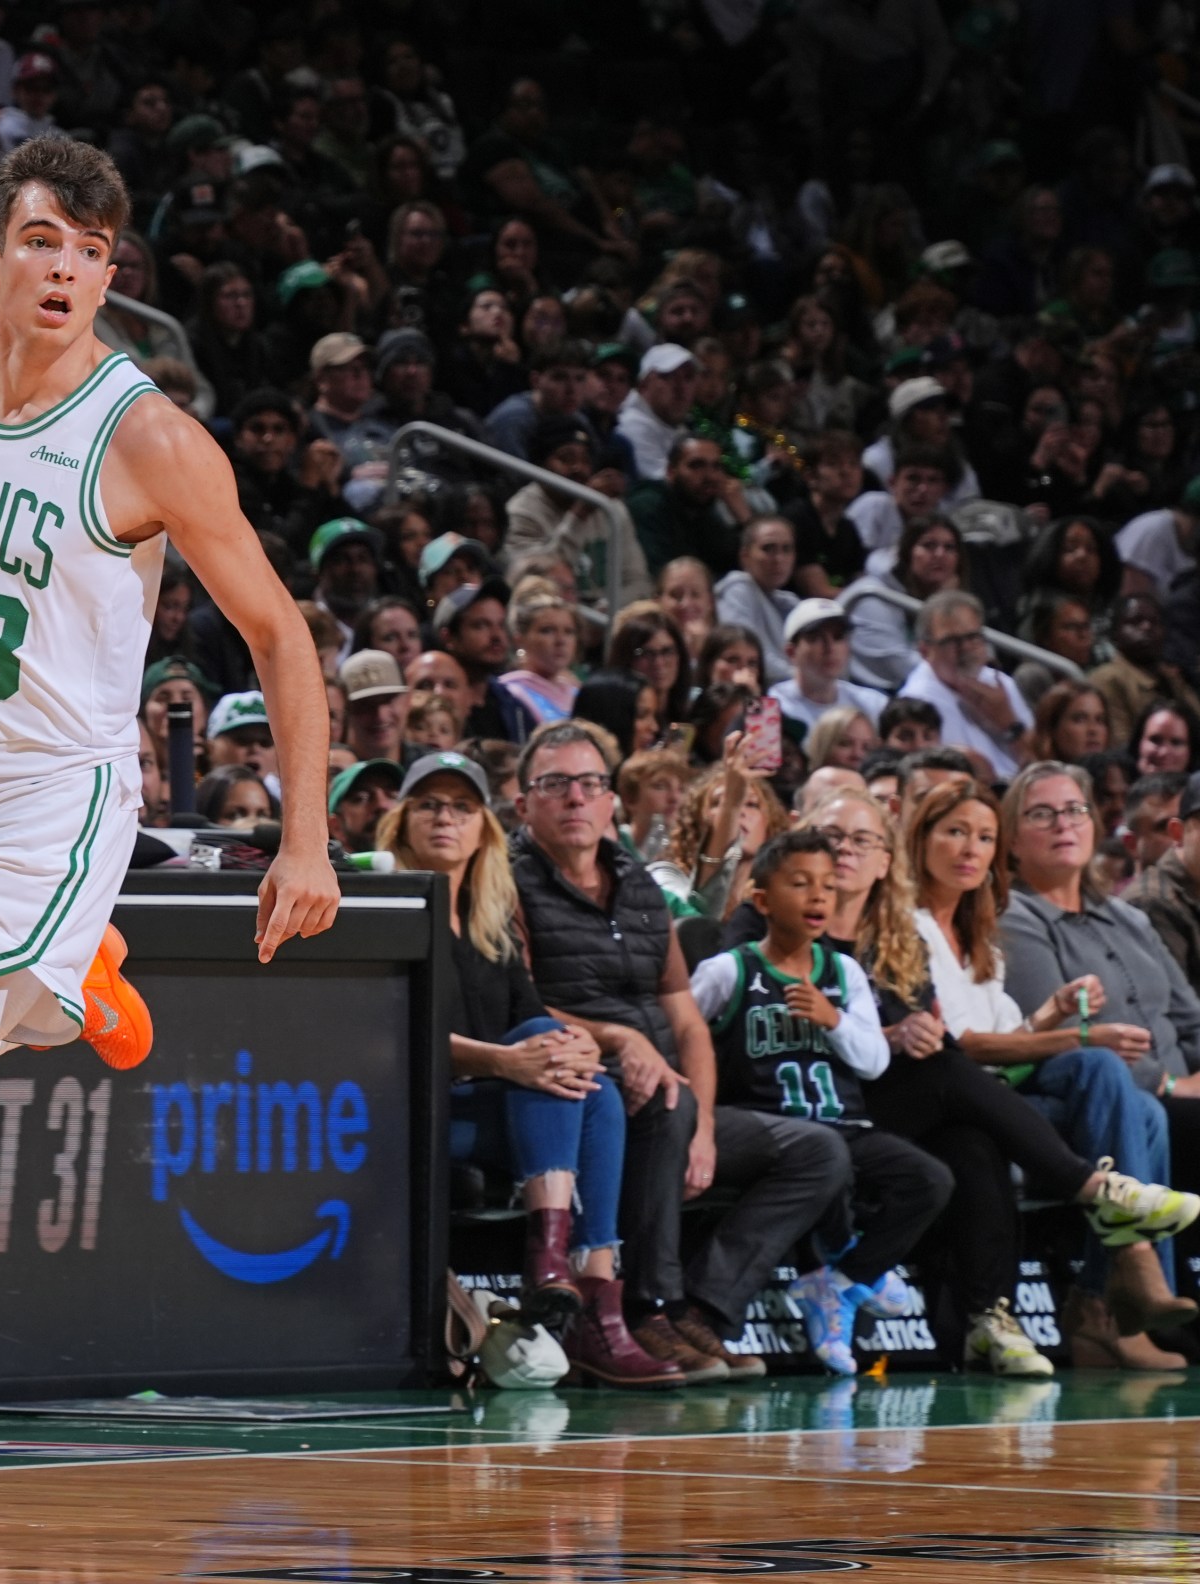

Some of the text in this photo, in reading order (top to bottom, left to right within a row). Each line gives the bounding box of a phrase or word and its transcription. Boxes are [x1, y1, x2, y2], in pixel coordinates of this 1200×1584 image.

[29, 445, 80, 470] Amica
[151, 1050, 371, 1201] prime
[775, 1061, 844, 1123] 11
[37, 1076, 112, 1254] 31
